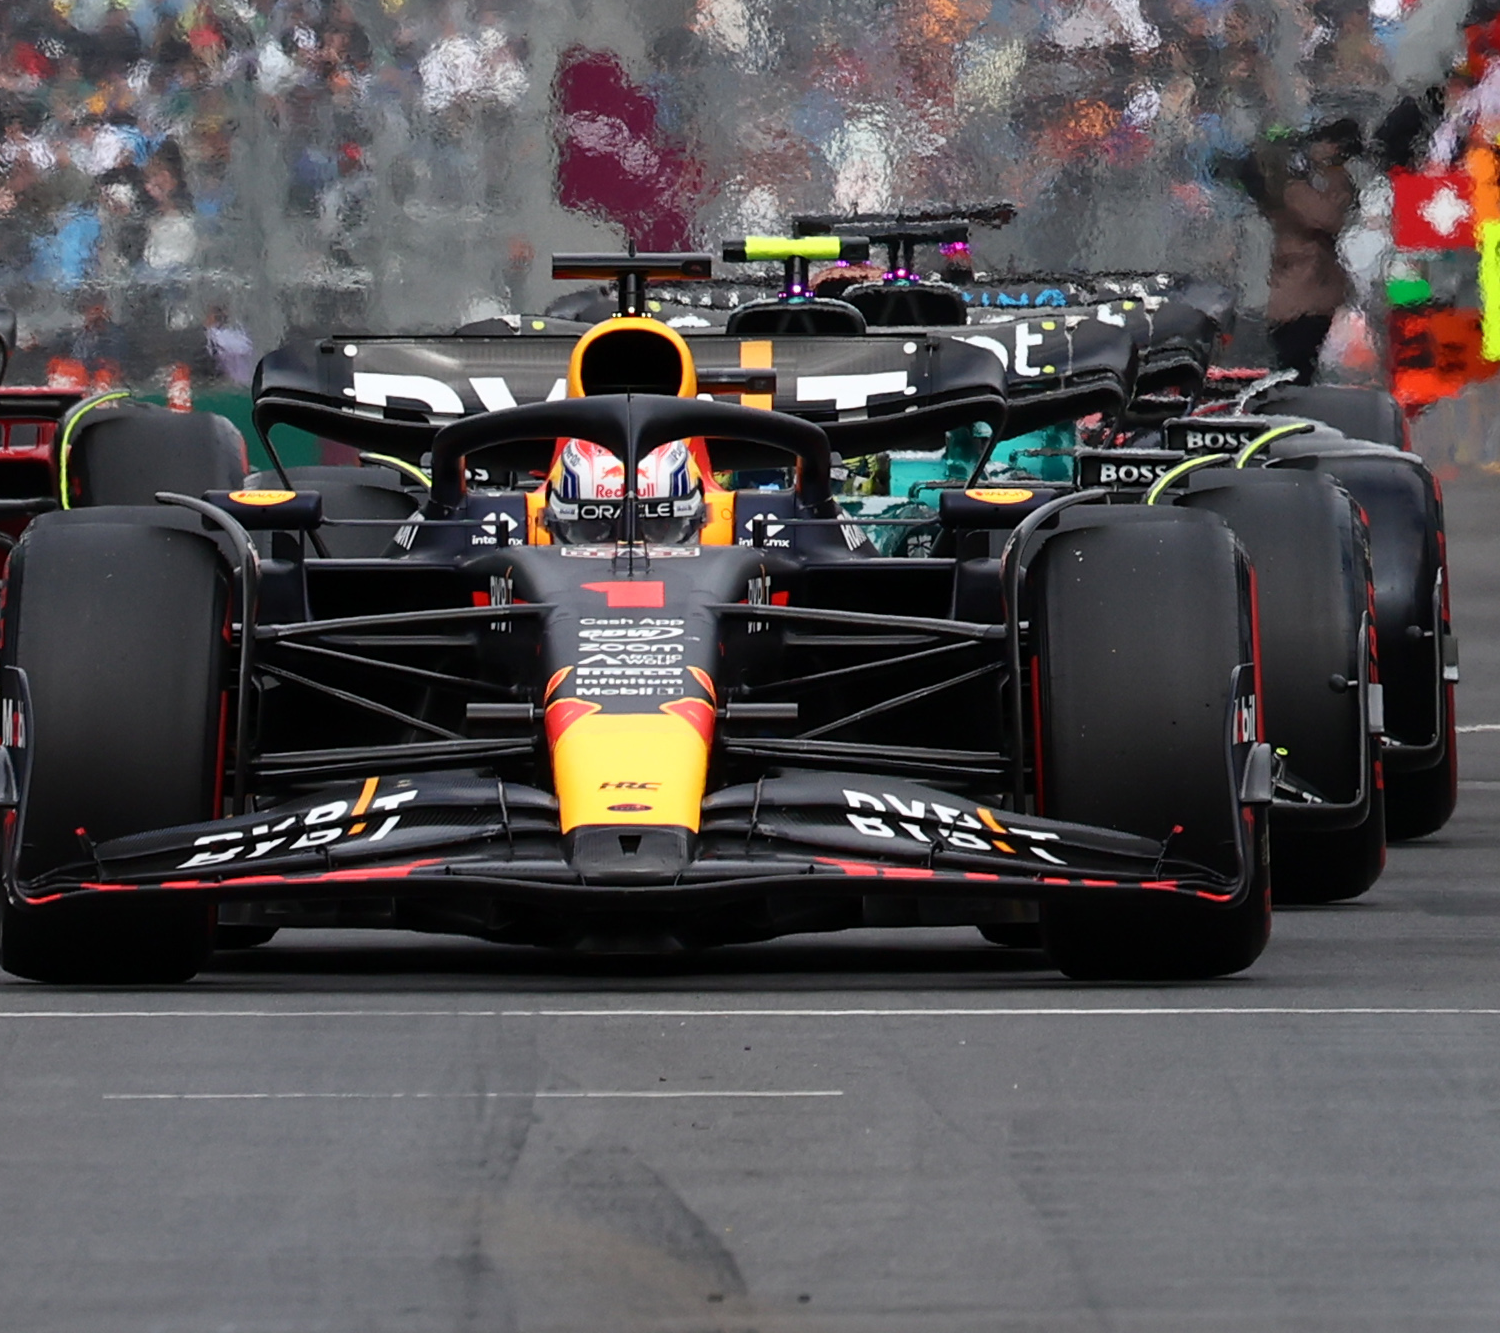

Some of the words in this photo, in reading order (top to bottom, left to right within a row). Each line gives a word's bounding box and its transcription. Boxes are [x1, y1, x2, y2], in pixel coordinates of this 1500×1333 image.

[1186, 431, 1250, 450] BOSS
[1100, 464, 1168, 484] BOSS
[595, 483, 626, 498] Red
[580, 581, 665, 608] 1
[639, 618, 685, 626] App
[576, 687, 654, 696] Mobil
